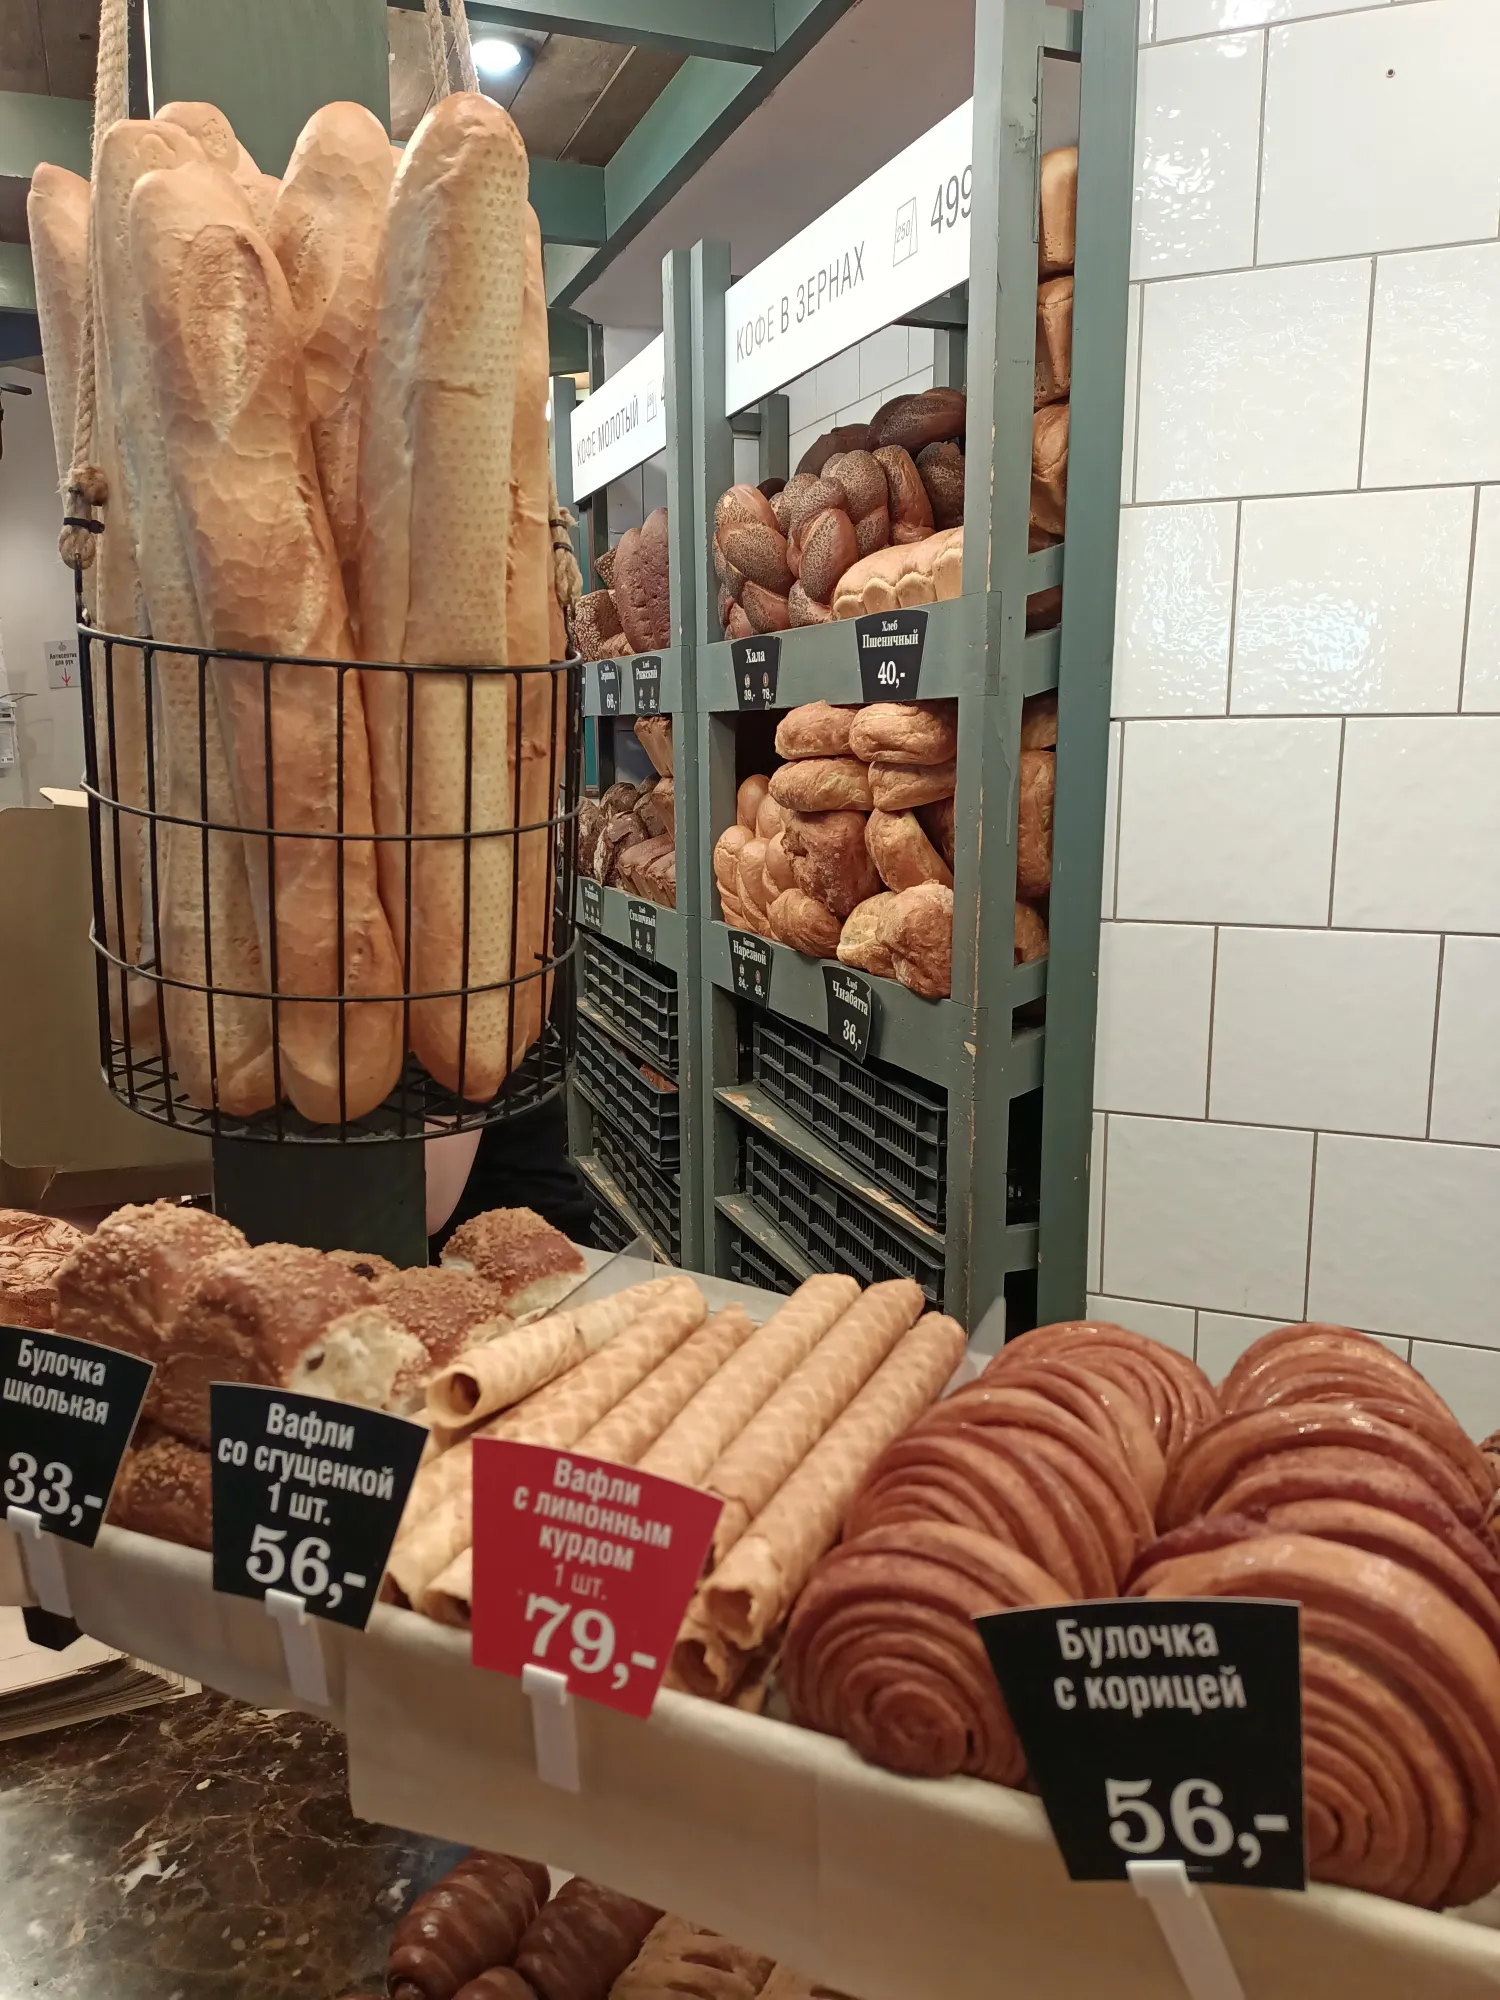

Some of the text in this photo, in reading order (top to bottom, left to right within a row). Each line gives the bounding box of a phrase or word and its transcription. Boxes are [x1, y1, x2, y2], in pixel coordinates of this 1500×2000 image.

[896, 220, 912, 244] 250
[737, 240, 865, 363] КОФЕ В ЗЕРНАХ
[577, 394, 640, 467] КОФЕ МОЛОТЫЙ
[862, 629, 919, 648] Пшеничный
[881, 620, 899, 632] Хлеб
[745, 648, 766, 664] Хала
[877, 660, 906, 688] 40,-
[732, 940, 767, 965] Нарезной
[832, 980, 868, 1016] Чиабатта
[845, 976, 858, 991] Хлеб
[842, 1019, 862, 1051] 36,-
[17, 1338, 107, 1387] Булочка
[3, 1375, 110, 1426] школьная
[266, 1402, 355, 1452] Вафли
[3, 1451, 103, 1528] 33,-
[217, 1436, 395, 1500] со сгущенкой
[553, 1457, 641, 1507] Вафли
[266, 1482, 332, 1526] 1 шт.
[513, 1486, 672, 1550] с лимонным
[245, 1524, 367, 1609] 56,-
[538, 1524, 635, 1572] курдом
[552, 1562, 607, 1601] 1 шт.
[524, 1593, 657, 1690] 79,-
[1055, 1618, 1220, 1669] Булочка
[1053, 1664, 1248, 1719] с корицей
[1104, 1778, 1290, 1869] 56,-
